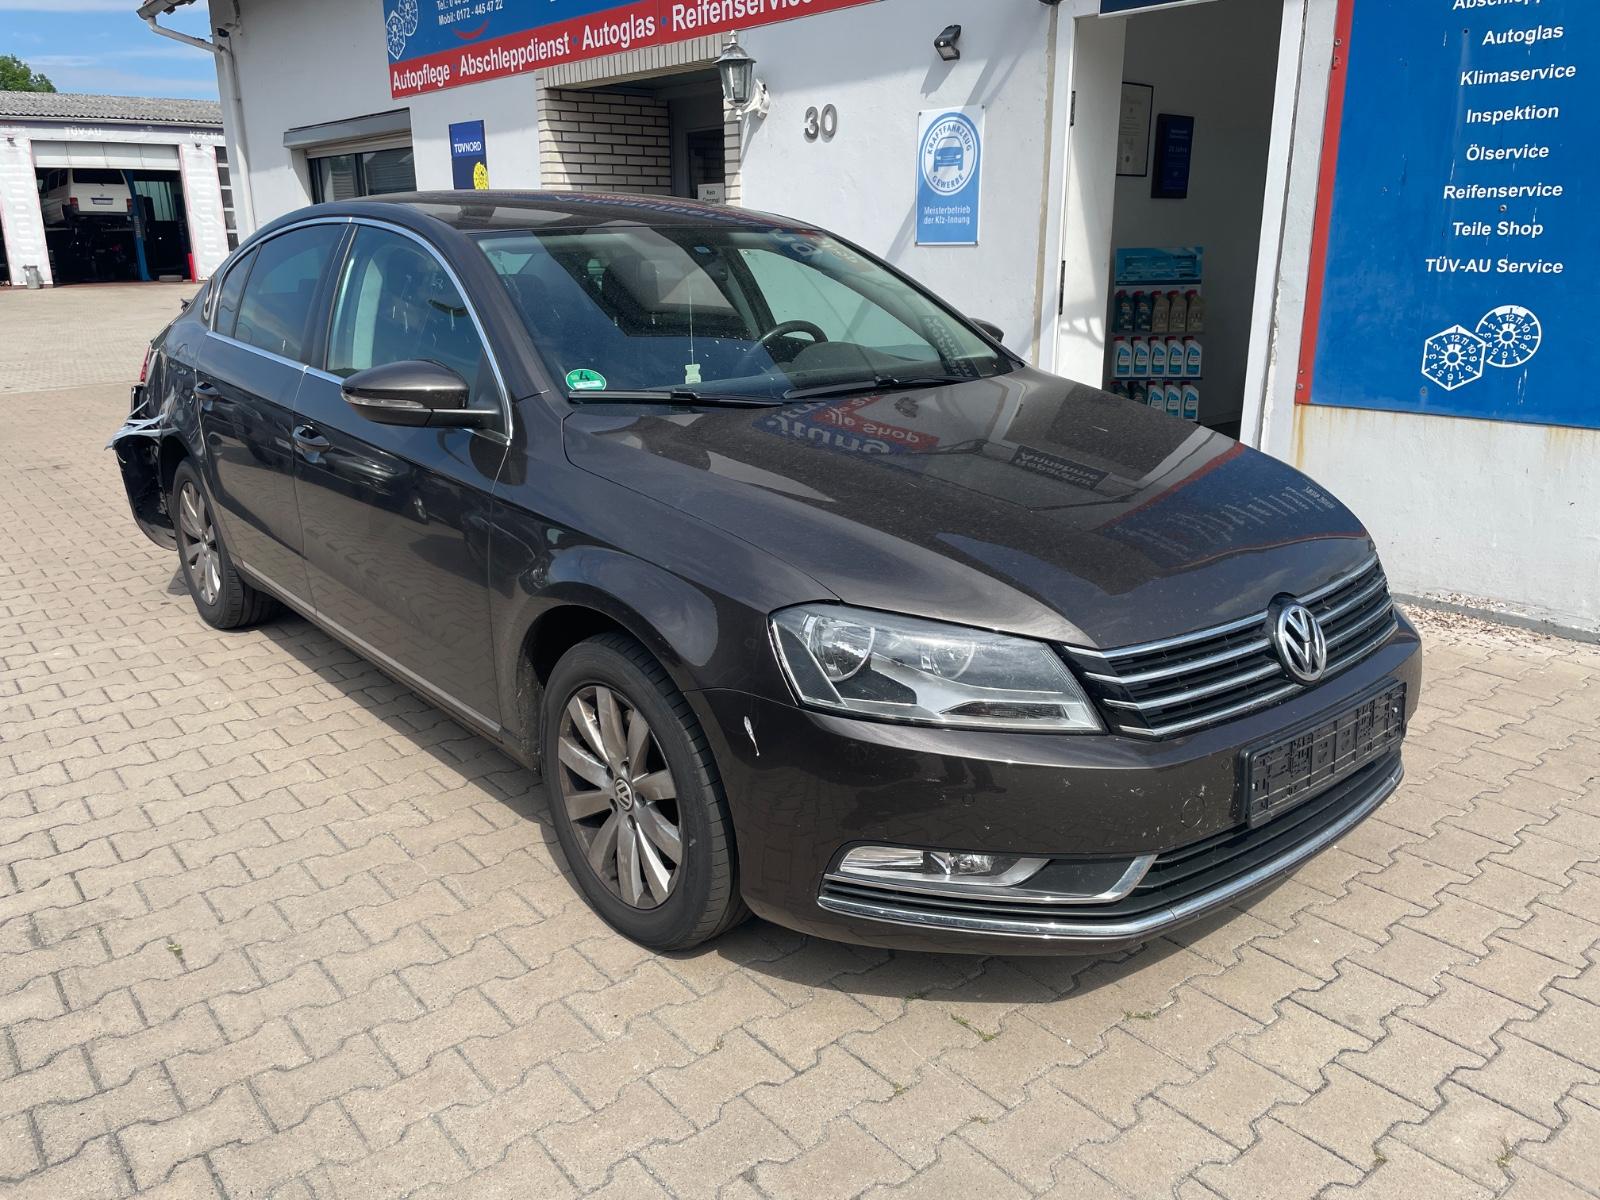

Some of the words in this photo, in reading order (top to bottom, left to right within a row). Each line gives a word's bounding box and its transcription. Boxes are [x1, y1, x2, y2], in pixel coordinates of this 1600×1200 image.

[438, 12, 456, 26] Mobil:
[456, 7, 470, 21] 0172
[474, 3, 486, 16] 445
[486, 0, 494, 12] 47
[1481, 25, 1564, 46] Autoglas
[393, 63, 450, 91] Autopflege
[460, 31, 570, 77] Abschleppdienst
[581, 16, 656, 51] Autoglas
[671, 0, 813, 32] Reifenserv
[1460, 64, 1577, 86] Klimaservice
[804, 103, 838, 140] 30
[1466, 105, 1560, 126] Inspektion
[927, 123, 972, 155] KRAFTFAHRZEUG
[1466, 144, 1550, 161] Ölservice
[932, 174, 964, 189] GEWERBE
[1443, 182, 1564, 200] Reifenservice
[923, 205, 971, 216] Meisterbetrieb
[923, 216, 935, 225] der
[1452, 222, 1492, 236] Teile
[1496, 221, 1544, 239] Shop
[1425, 256, 1492, 273] TÜV-AU
[1496, 258, 1564, 274] Service
[579, 370, 590, 382] 4
